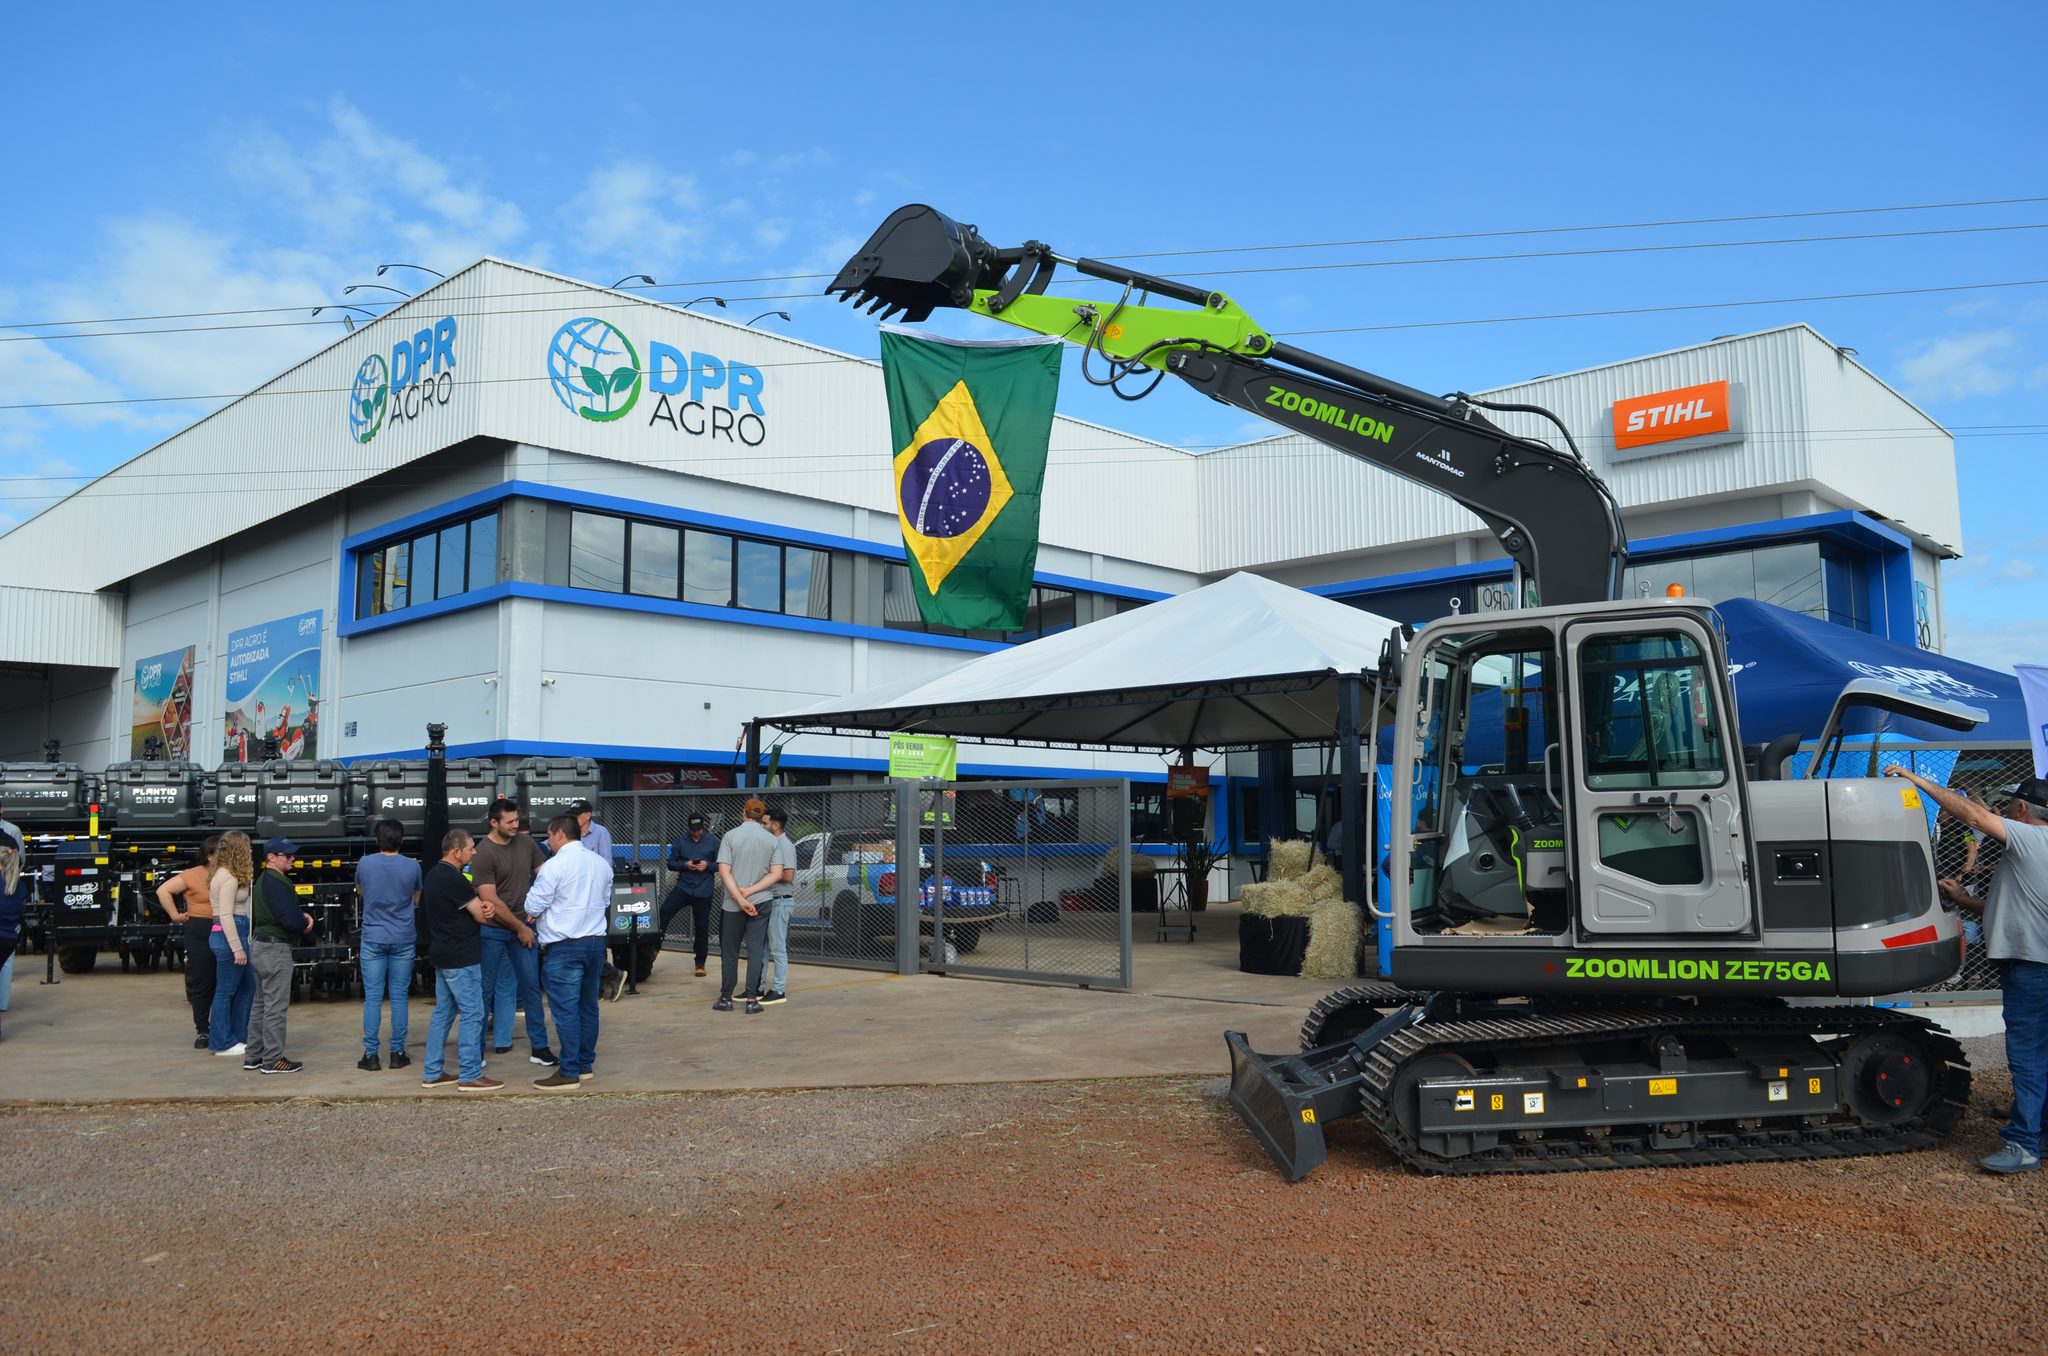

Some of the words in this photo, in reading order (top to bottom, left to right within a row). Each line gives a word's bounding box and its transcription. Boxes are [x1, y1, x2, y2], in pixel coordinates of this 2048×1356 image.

[390, 315, 456, 394] DPR
[650, 340, 766, 416] DPR
[388, 371, 454, 430] AGRO
[649, 394, 766, 447] AGRO
[1265, 386, 1395, 443] ZOOMLION
[1626, 398, 1714, 432] STIHL
[1416, 451, 1465, 477] MANTOMAC
[231, 638, 244, 652] DPR
[244, 632, 262, 648] AGRO
[230, 647, 270, 668] AUTORIZADA
[229, 669, 248, 685] STIHL!
[905, 742, 924, 751] VENDA
[132, 788, 178, 796] PLANTIO
[135, 796, 175, 804] DIRETO
[276, 794, 328, 804] PLANTIO
[398, 797, 427, 807] HID
[448, 797, 488, 806] PLUS
[280, 804, 326, 813] DIRETO
[1534, 840, 1564, 848] ZOOM
[1565, 957, 1719, 981] ZOOMLION
[1725, 960, 1831, 982] ZE75GA
